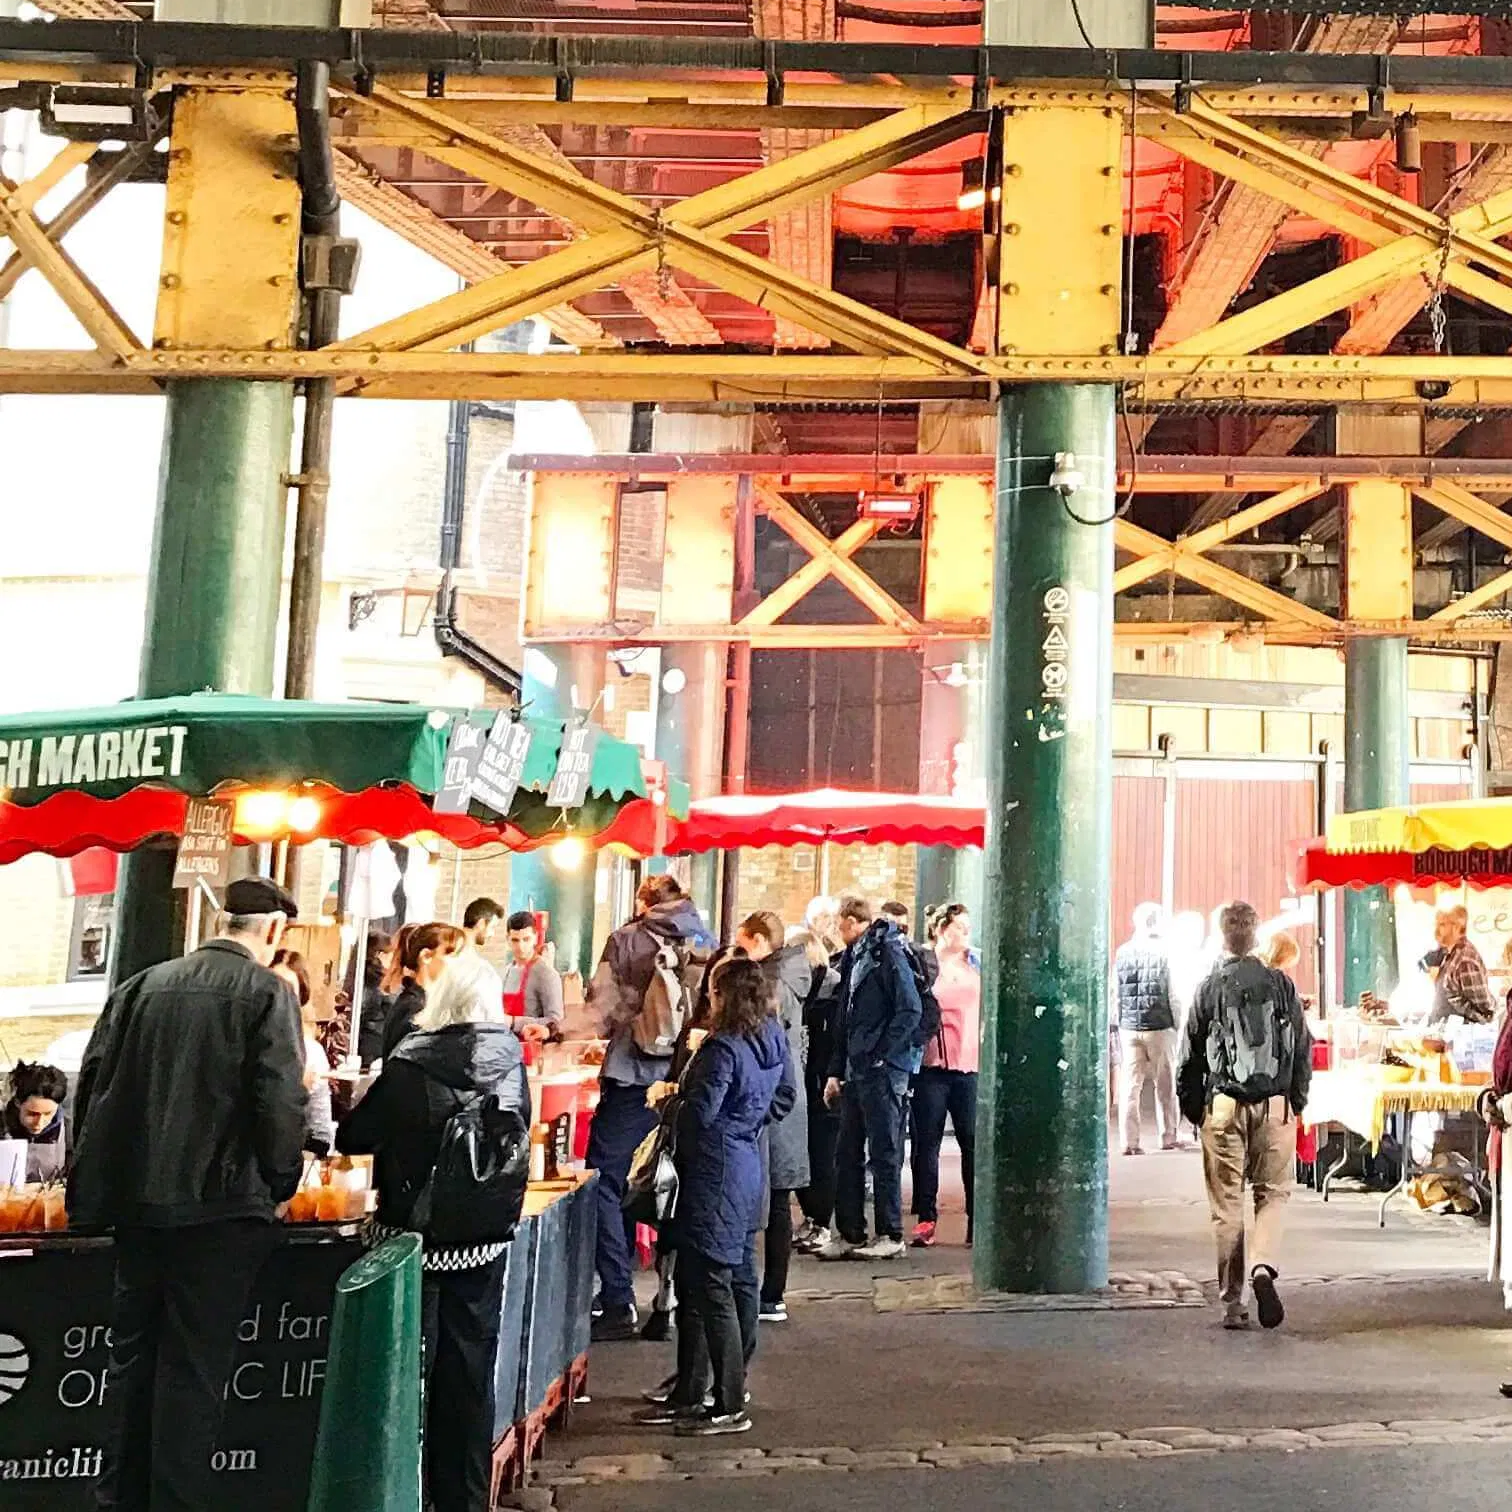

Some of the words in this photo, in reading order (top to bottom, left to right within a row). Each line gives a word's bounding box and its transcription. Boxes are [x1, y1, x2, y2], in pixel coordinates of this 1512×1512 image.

[37, 725, 188, 787] MARKET
[1415, 848, 1490, 873] BOROUGH
[278, 1302, 328, 1341] far
[281, 1359, 327, 1398] LIF
